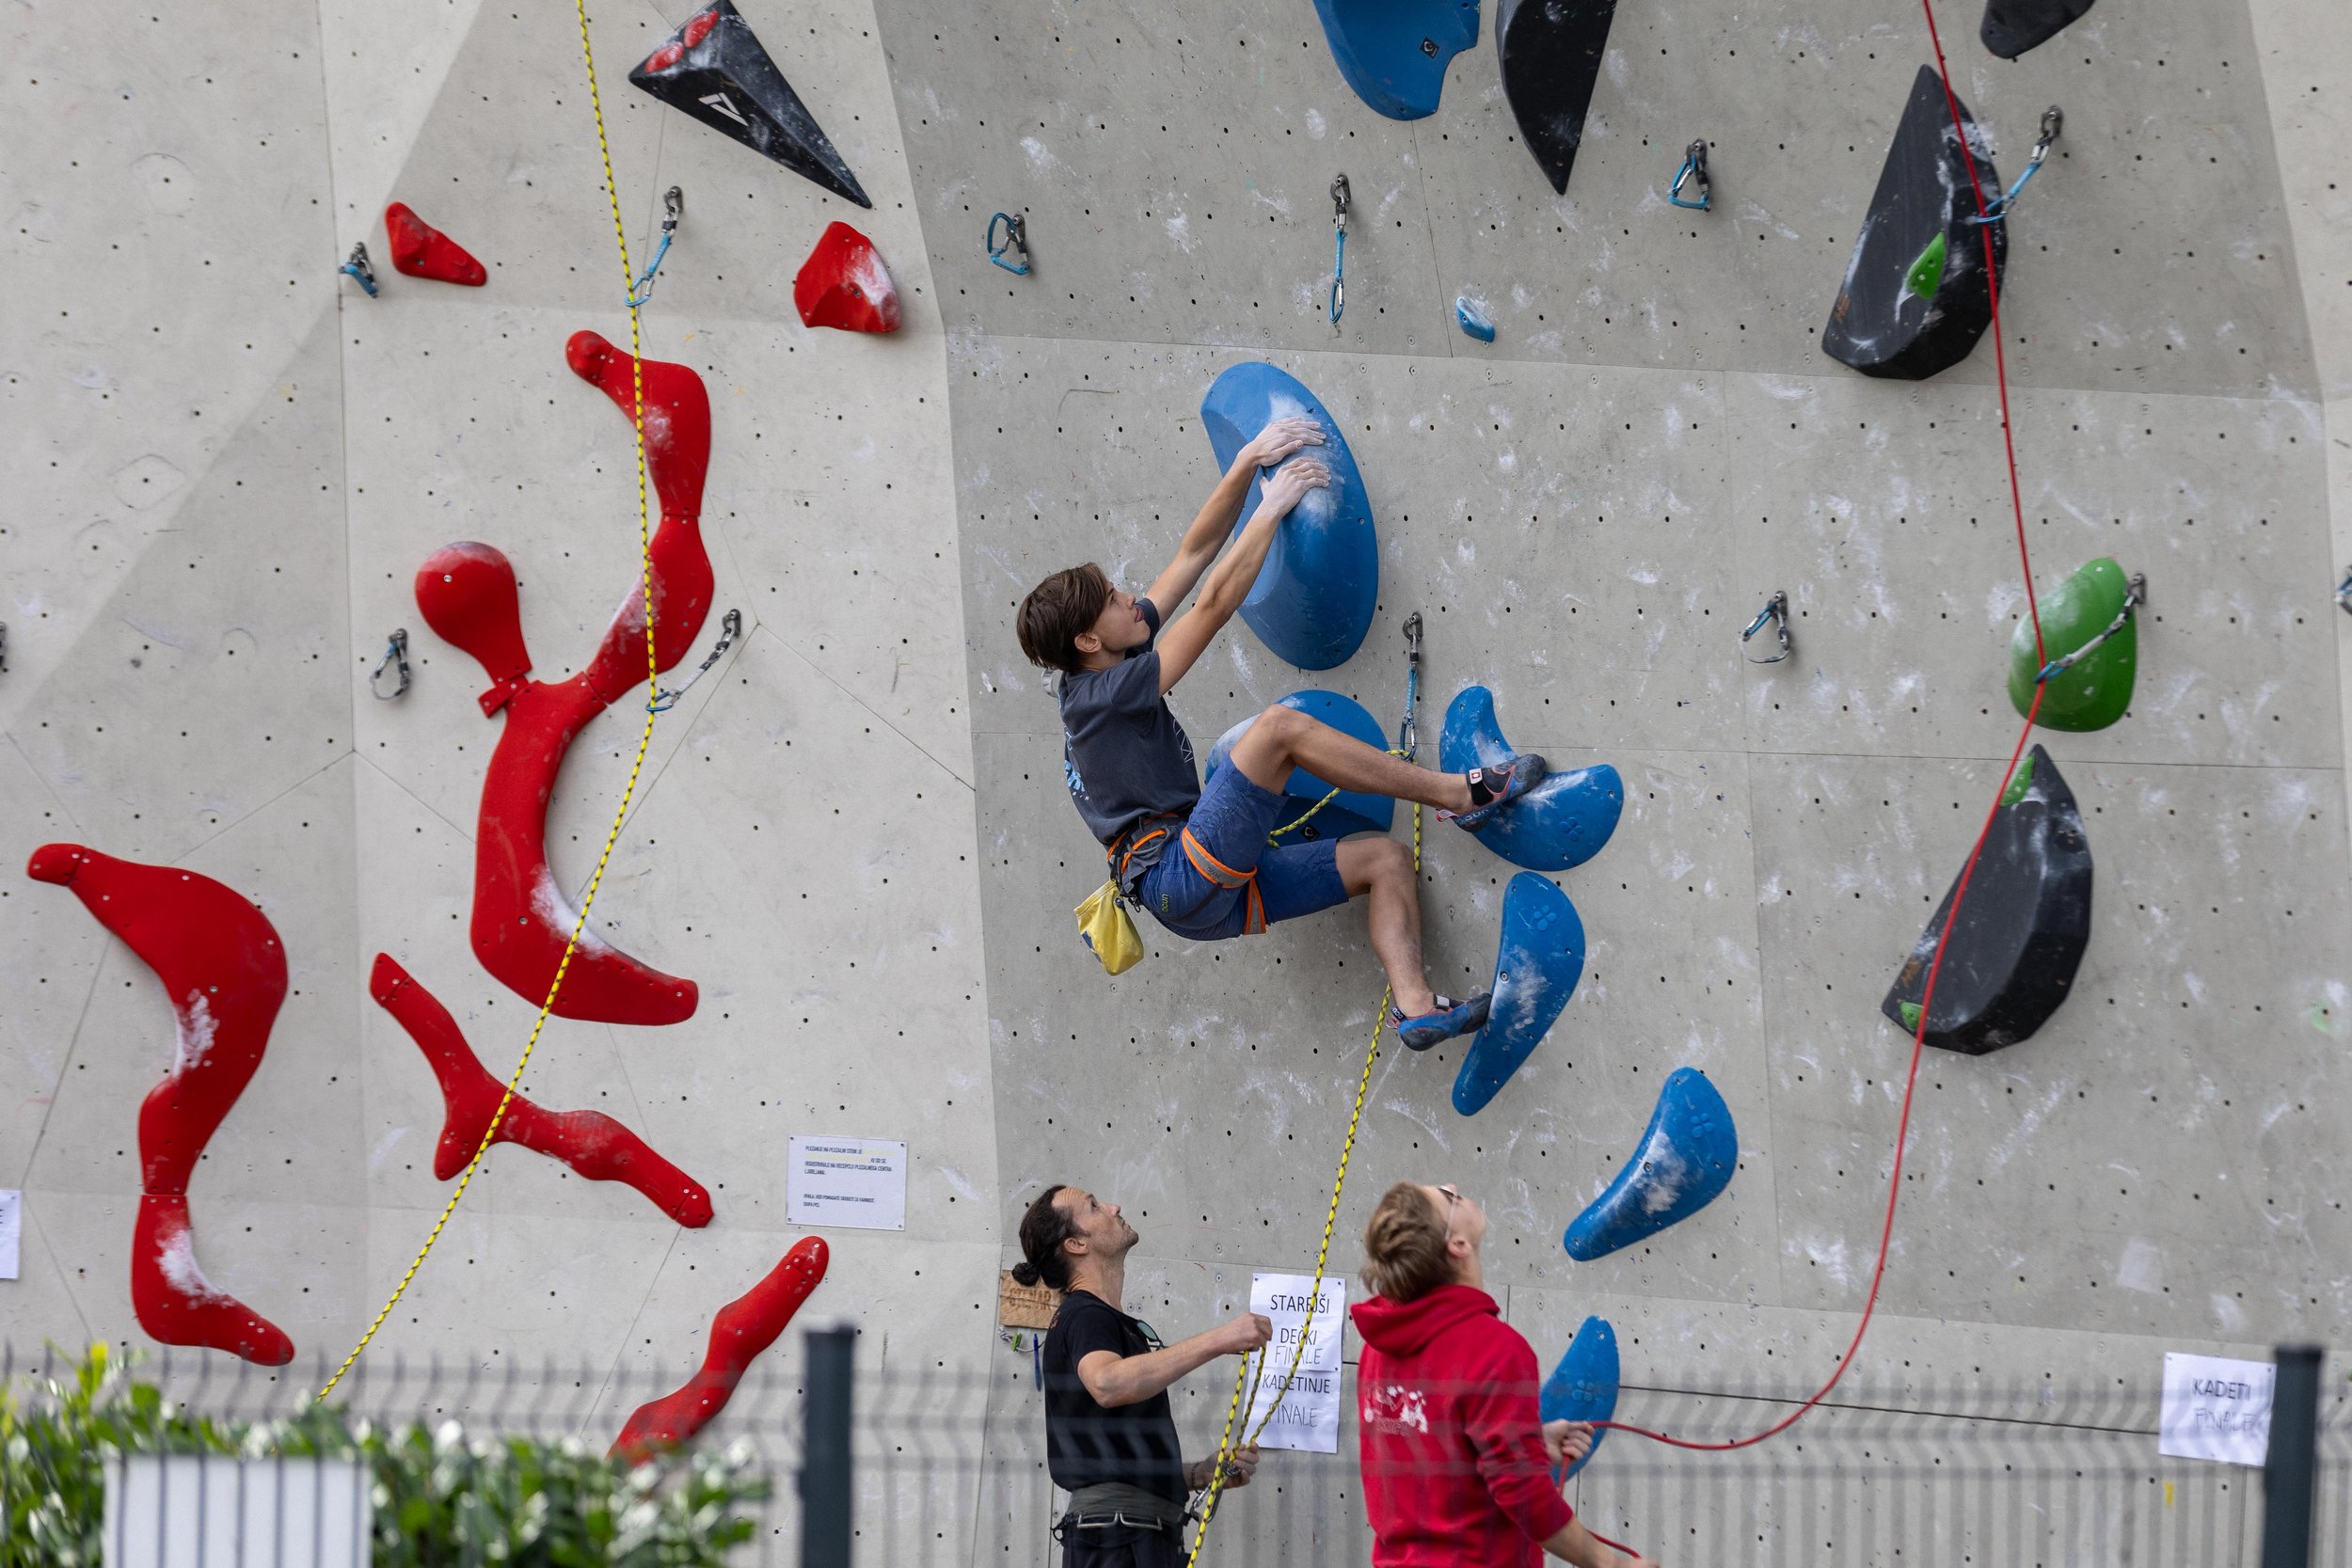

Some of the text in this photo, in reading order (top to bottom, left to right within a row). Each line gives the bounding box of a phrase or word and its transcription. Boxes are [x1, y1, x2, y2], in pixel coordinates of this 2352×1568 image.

[1270, 1292, 1329, 1314] STAREJŠI
[1280, 1324, 1317, 1345] DEČKI
[1262, 1373, 1330, 1394] KADETINJE
[2192, 1378, 2251, 1401] KADETI
